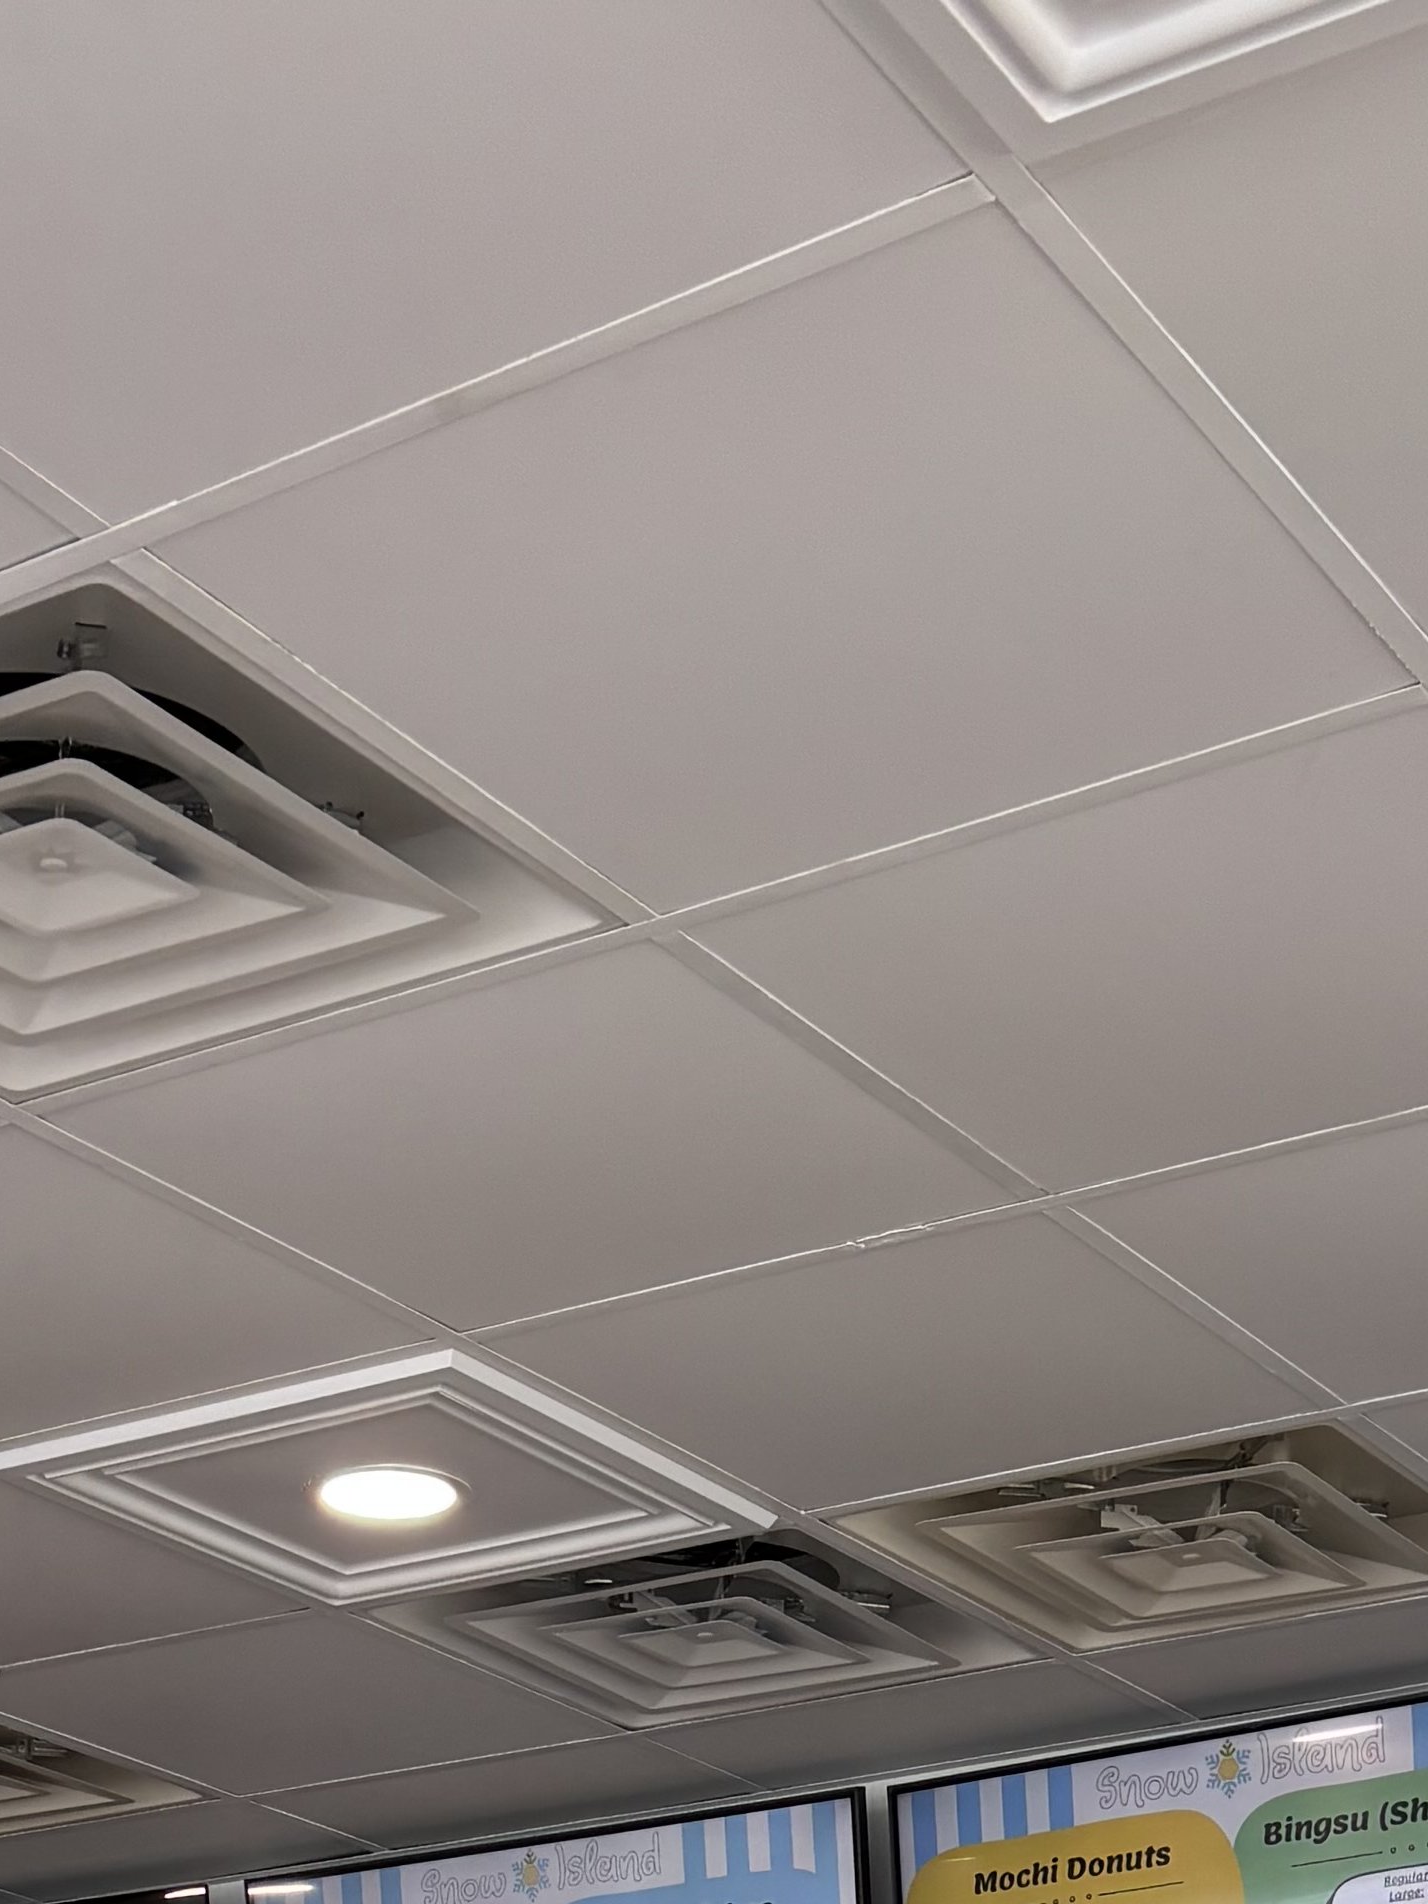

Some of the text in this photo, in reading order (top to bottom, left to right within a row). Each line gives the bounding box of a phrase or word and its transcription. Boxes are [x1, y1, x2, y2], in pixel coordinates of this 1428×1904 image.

[1096, 1715, 1386, 1810] Snow Island
[1263, 1810, 1369, 1846] Bingsu
[553, 1831, 662, 1890] Island
[974, 1845, 1171, 1895] Mochi Donuts
